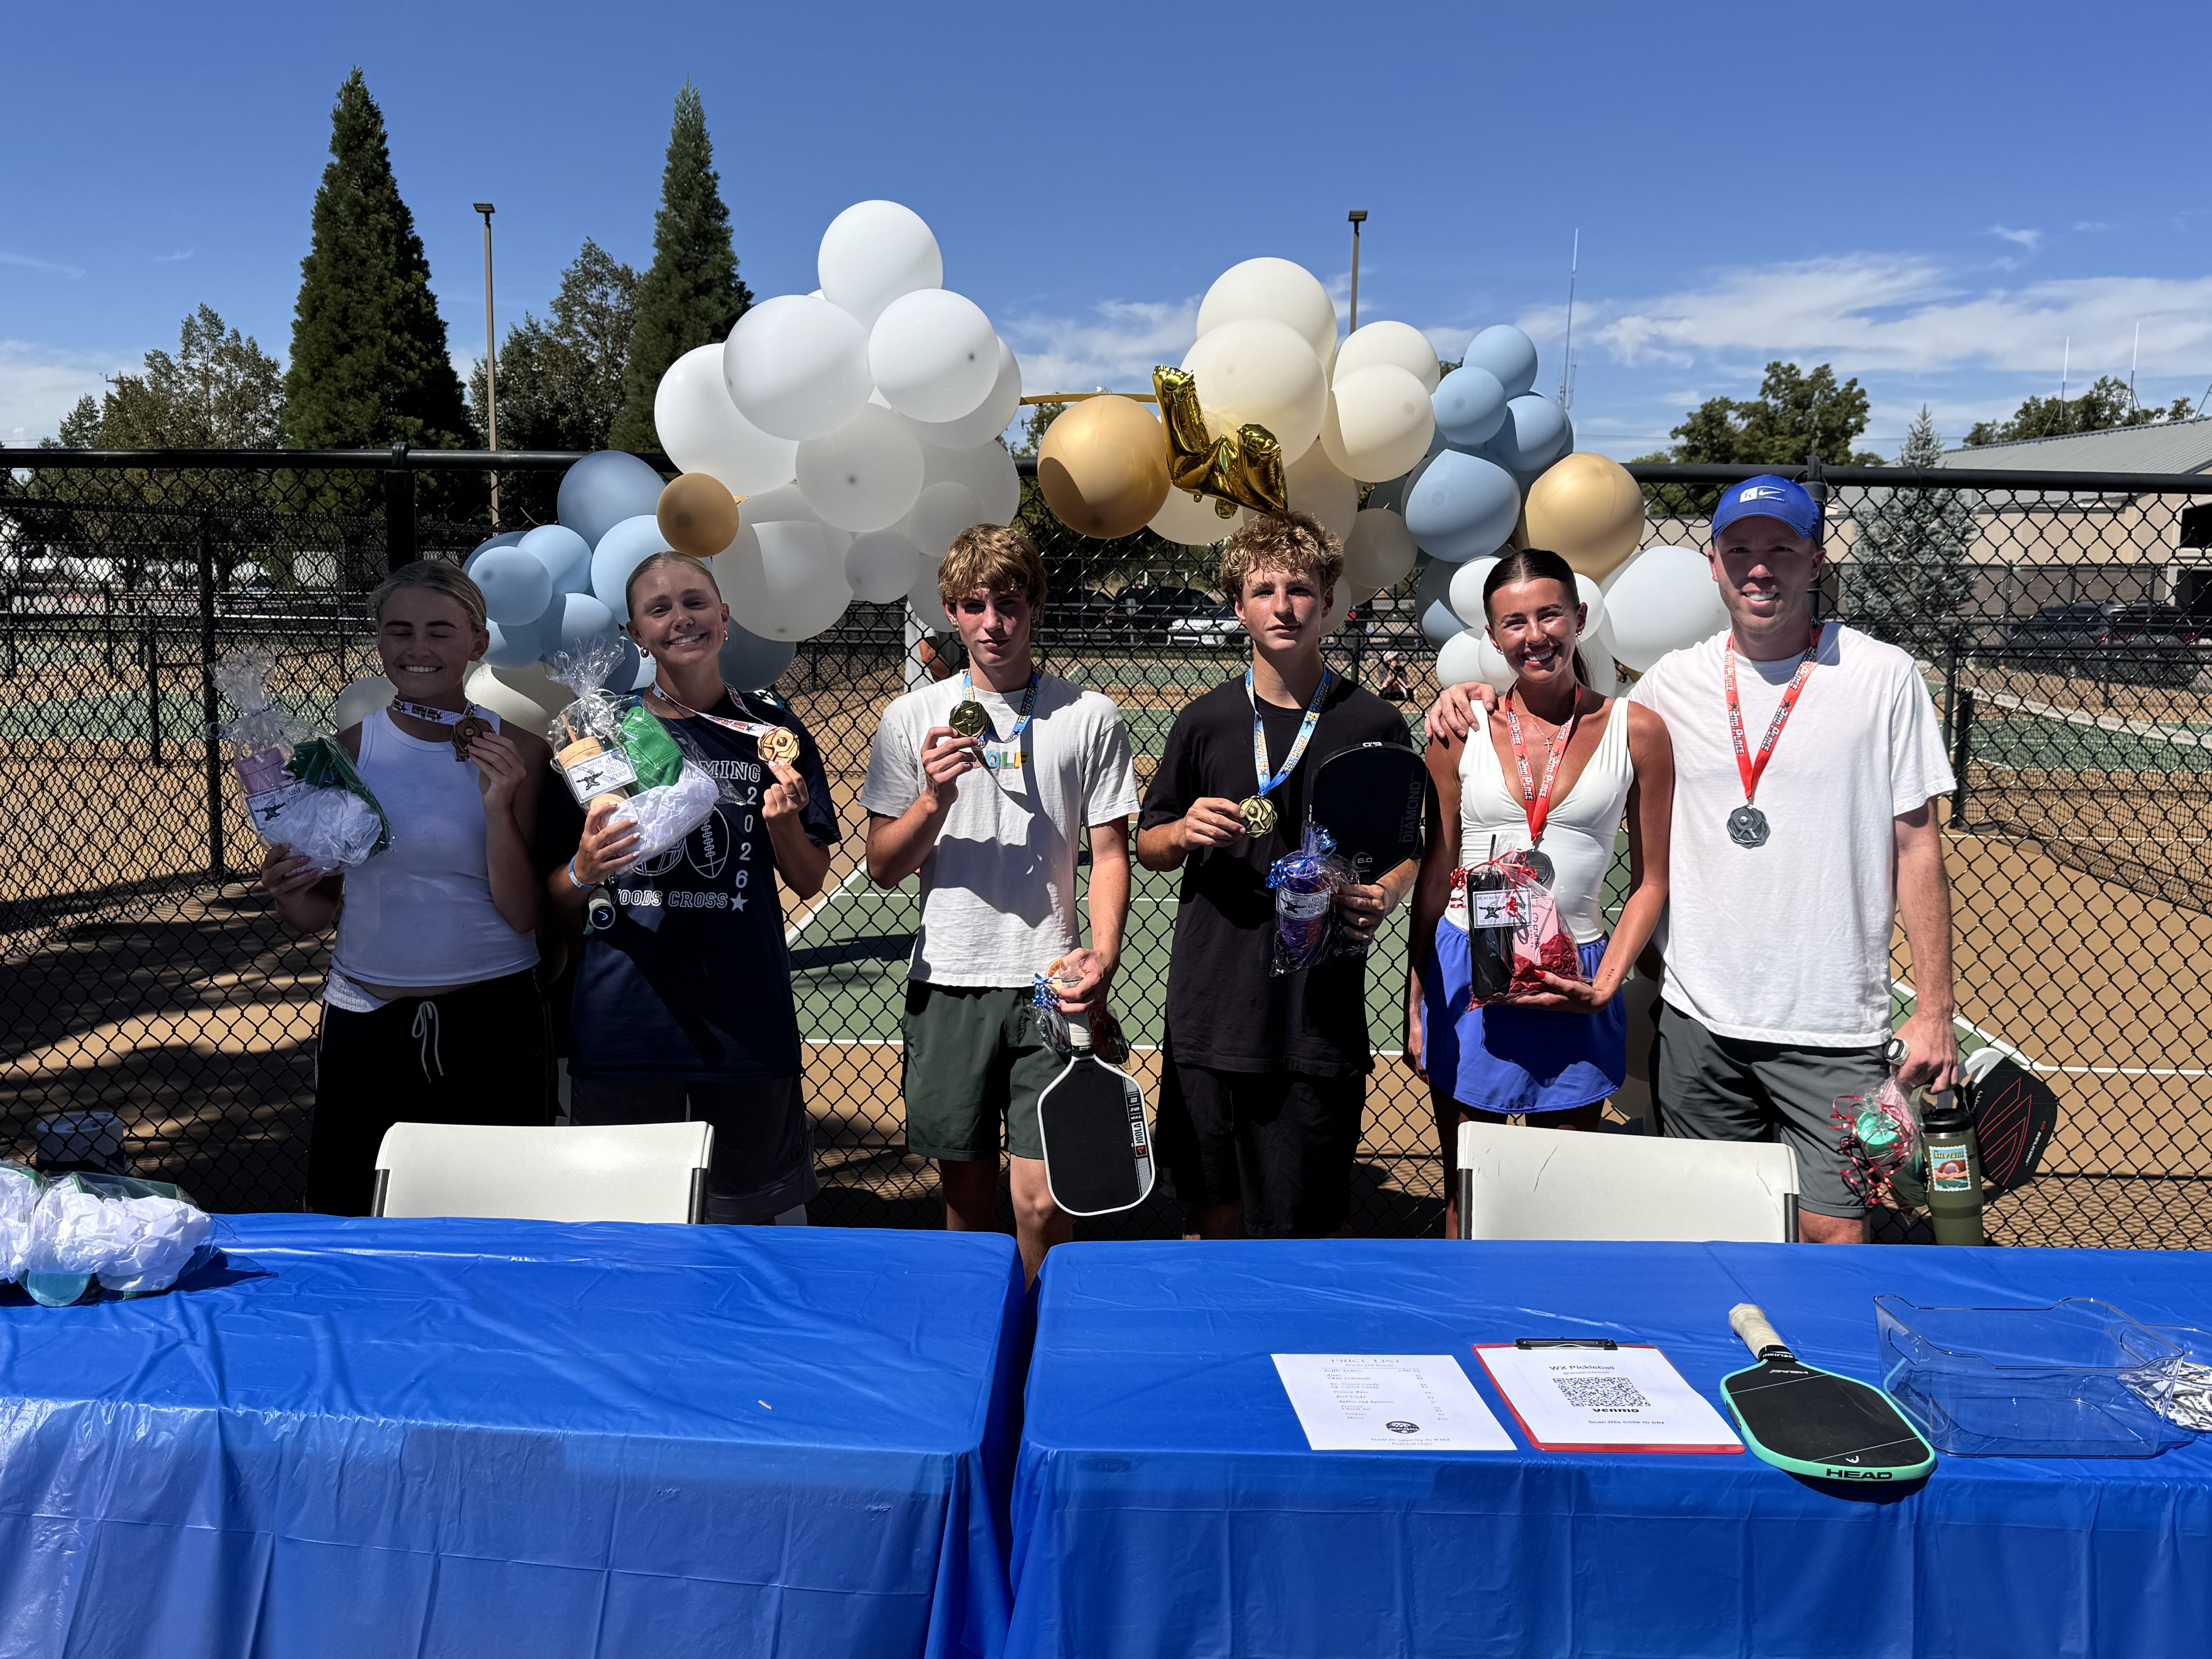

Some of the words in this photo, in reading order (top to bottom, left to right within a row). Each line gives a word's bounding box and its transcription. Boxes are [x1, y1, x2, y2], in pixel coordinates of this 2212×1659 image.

[1725, 666, 1734, 691] PLACE
[1790, 664, 1810, 690] PLACE
[1313, 682, 1329, 707] PLACE
[1290, 735, 1308, 759] PLACE
[1510, 725, 1522, 745] PLACE
[1732, 728, 1745, 754] PLACE
[1761, 725, 1780, 752] PLACE
[699, 761, 761, 783] MING
[972, 750, 1029, 769] OLF
[1522, 776, 1534, 801] PLACE
[1539, 774, 1554, 799] PLACE
[1402, 781, 1421, 842] DIAMOND
[735, 786, 757, 888] 2026
[669, 891, 728, 908] CROSS
[1133, 1123, 1144, 1144] JOOLA
[1826, 1468, 1893, 1480] HEAD
